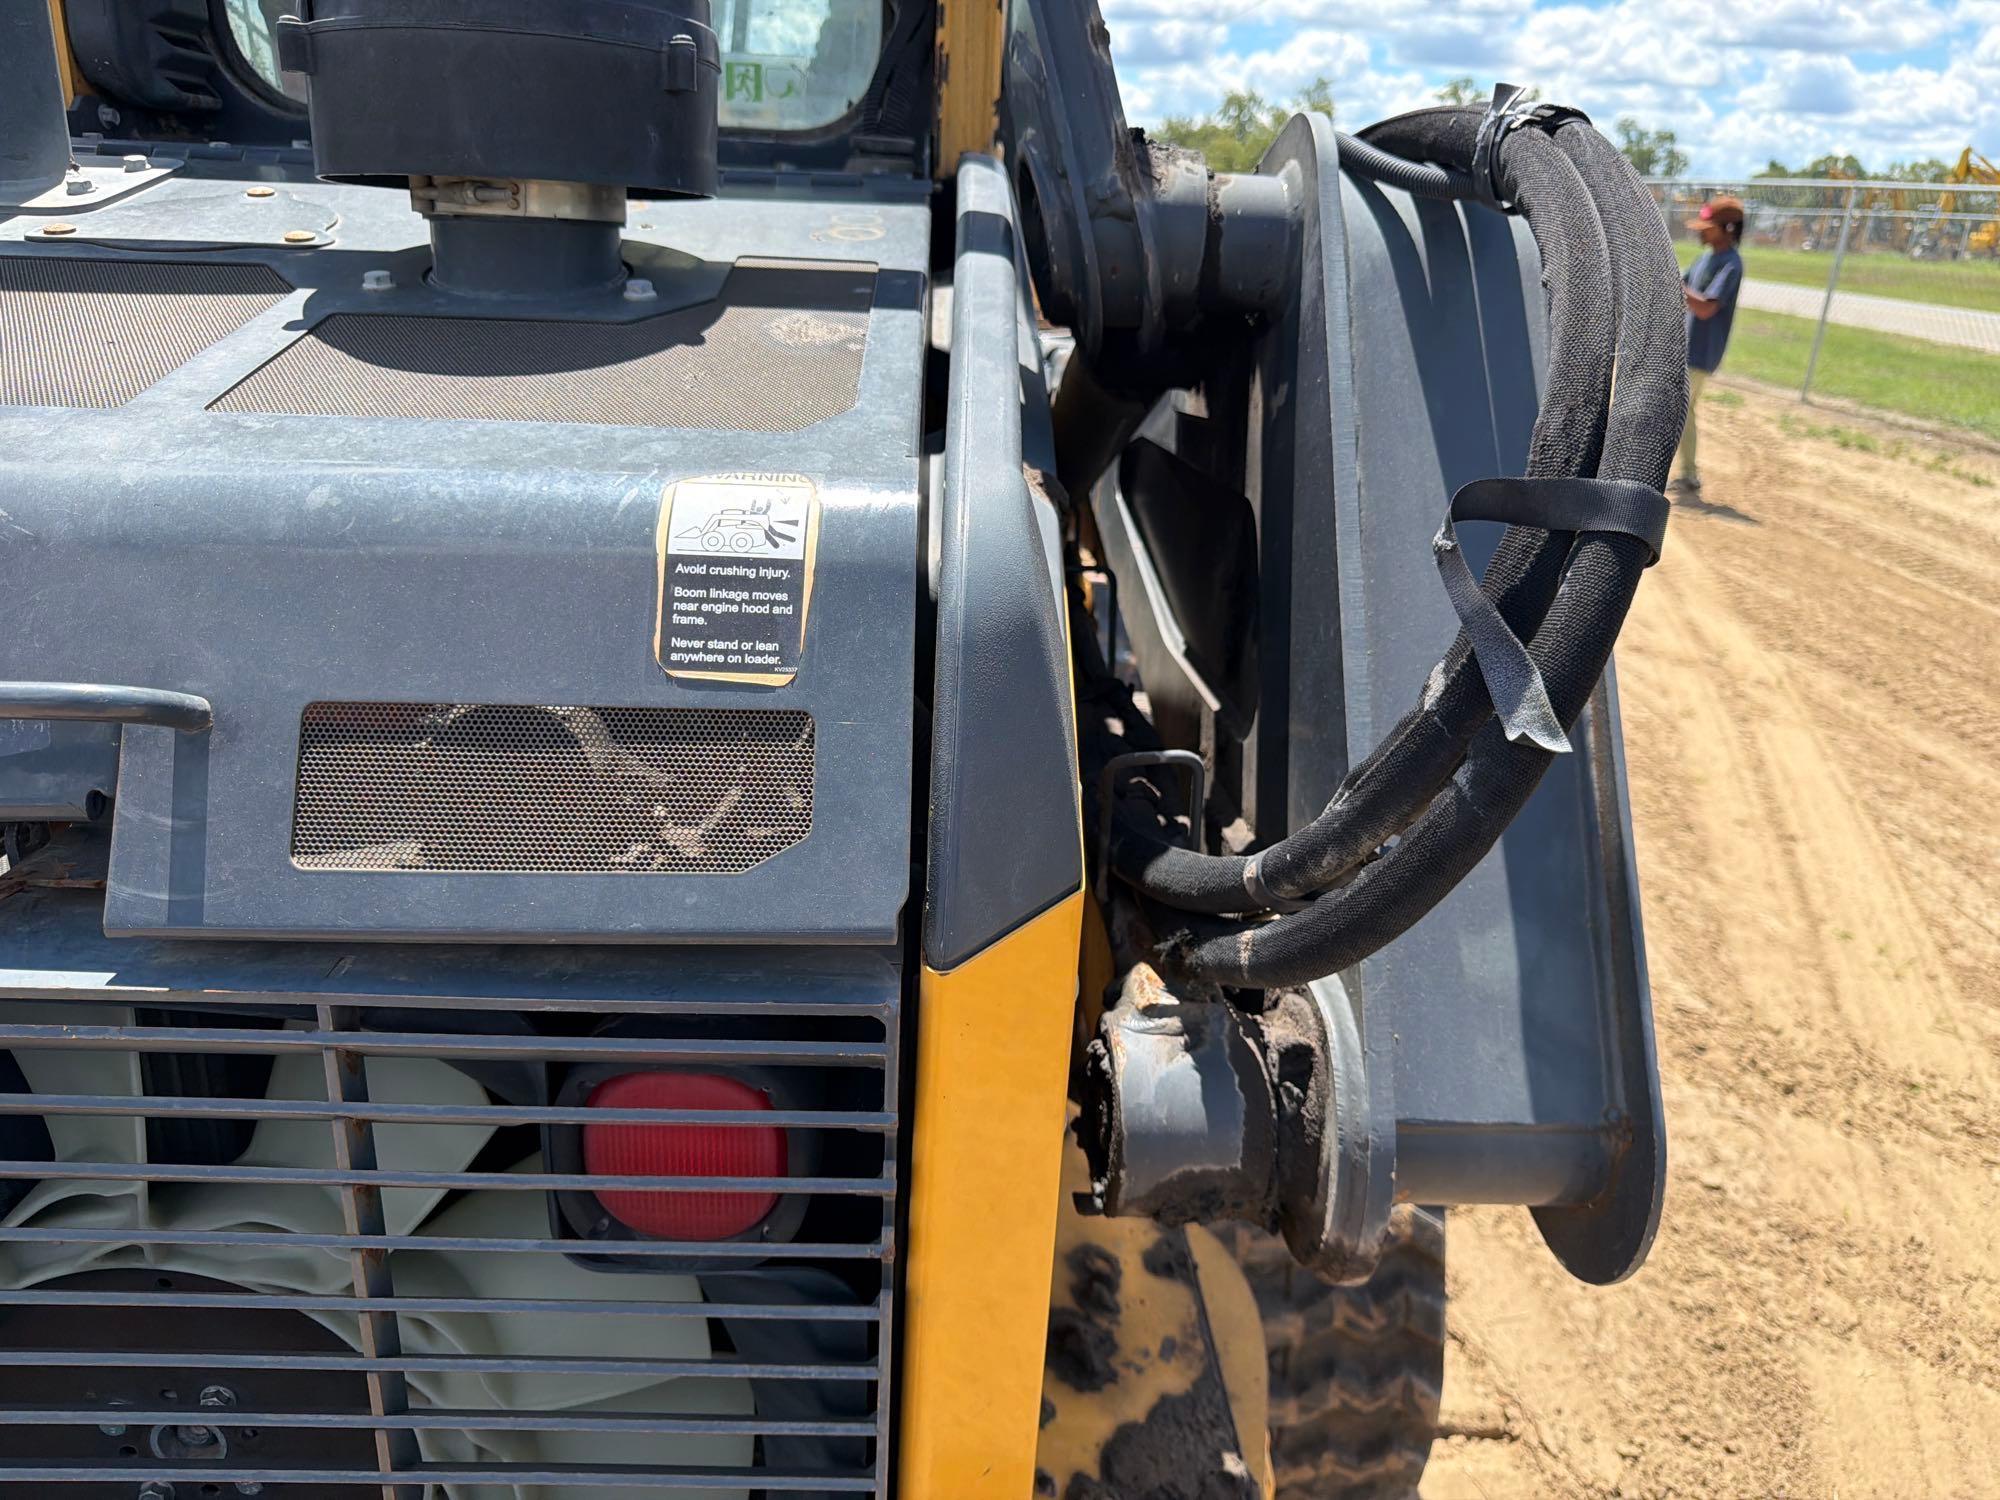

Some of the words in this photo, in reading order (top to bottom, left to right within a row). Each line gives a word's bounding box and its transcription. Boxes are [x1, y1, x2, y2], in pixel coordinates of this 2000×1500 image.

[675, 563, 707, 575] Avoid
[709, 565, 757, 579] crushing
[759, 566, 791, 580] injury.
[674, 587, 707, 598] Boom
[709, 588, 749, 601] linkage
[752, 591, 788, 601] moves
[673, 603, 699, 612] near
[701, 603, 739, 615] engine
[742, 603, 770, 614] hood
[772, 604, 793, 615] and
[672, 614, 707, 625] frame.
[671, 637, 705, 649] Never
[707, 639, 739, 650] stand
[741, 642, 754, 651] or
[756, 640, 779, 651] lean
[670, 652, 725, 666] anywhere
[727, 654, 742, 663] on
[744, 653, 781, 665] loader.
